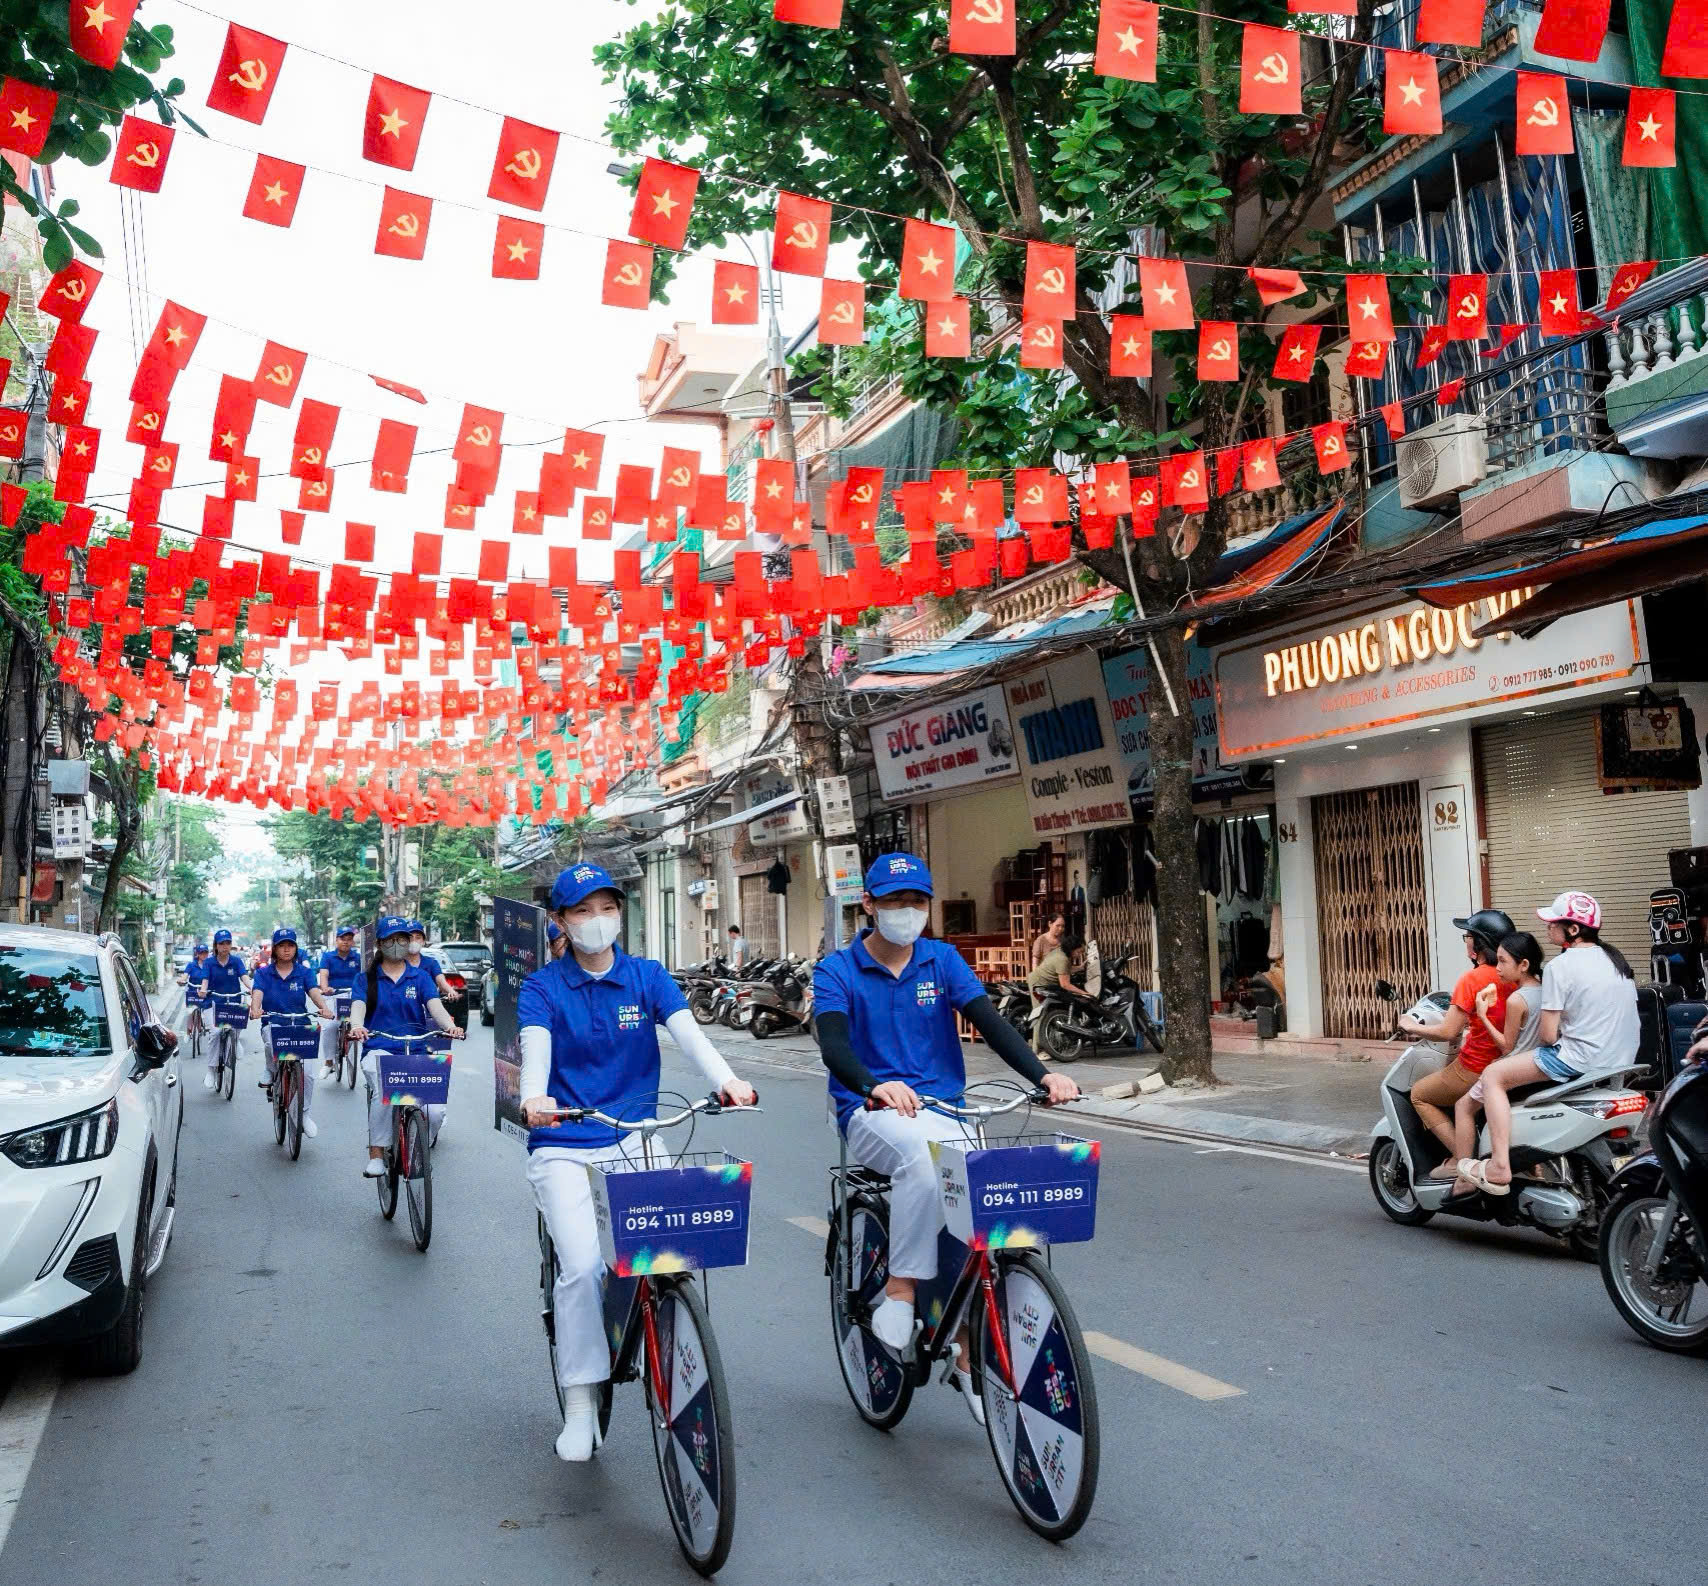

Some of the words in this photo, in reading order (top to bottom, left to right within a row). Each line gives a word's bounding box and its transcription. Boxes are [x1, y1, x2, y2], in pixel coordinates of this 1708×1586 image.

[1264, 623, 1381, 697] PHUONG
[1386, 601, 1482, 666] NGOC
[1395, 665, 1476, 697] ACCESSORIES
[1503, 674, 1521, 687] 0912
[1523, 670, 1537, 683] 777
[1538, 667, 1553, 680] 985
[1558, 662, 1577, 676] 0912
[1579, 657, 1598, 672] 090
[1435, 801, 1458, 825] 82
[1279, 822, 1298, 843] 84
[619, 1005, 639, 1013] SUN
[619, 1021, 640, 1030] CITY
[983, 1192, 1015, 1207] 094
[1020, 1190, 1038, 1204] 111
[1044, 1187, 1084, 1202] 8989
[986, 1182, 1019, 1191] Hotline
[626, 1215, 660, 1231] 094
[665, 1213, 685, 1227] 111
[691, 1209, 734, 1225] 8989
[629, 1205, 664, 1214] Hotline
